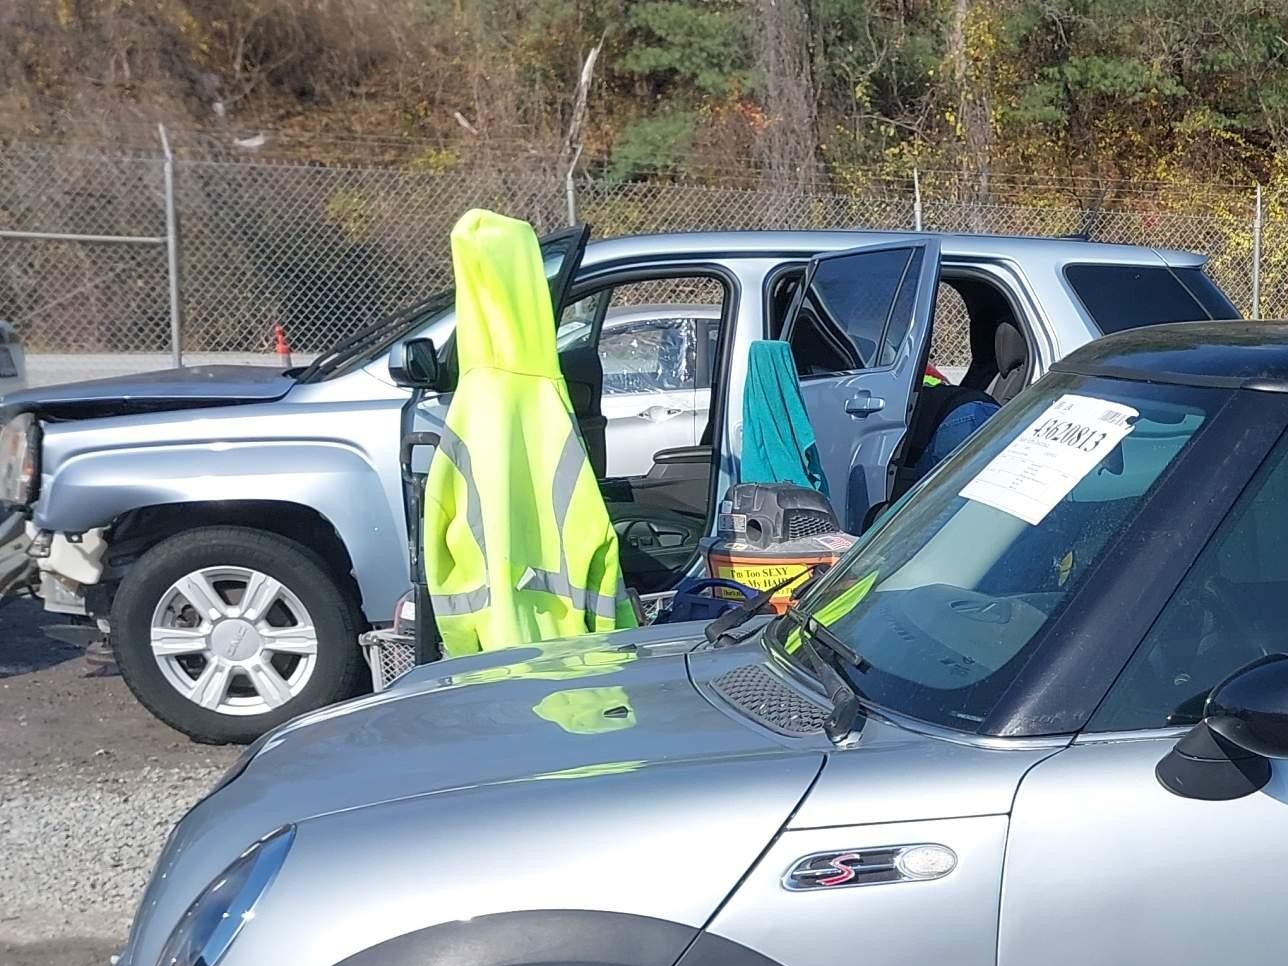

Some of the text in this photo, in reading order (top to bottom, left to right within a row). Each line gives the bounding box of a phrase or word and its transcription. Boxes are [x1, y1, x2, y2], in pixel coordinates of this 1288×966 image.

[1033, 418, 1108, 453] 43620813
[746, 569, 761, 578] Too
[762, 568, 788, 577] SEXY
[816, 853, 861, 886] S
